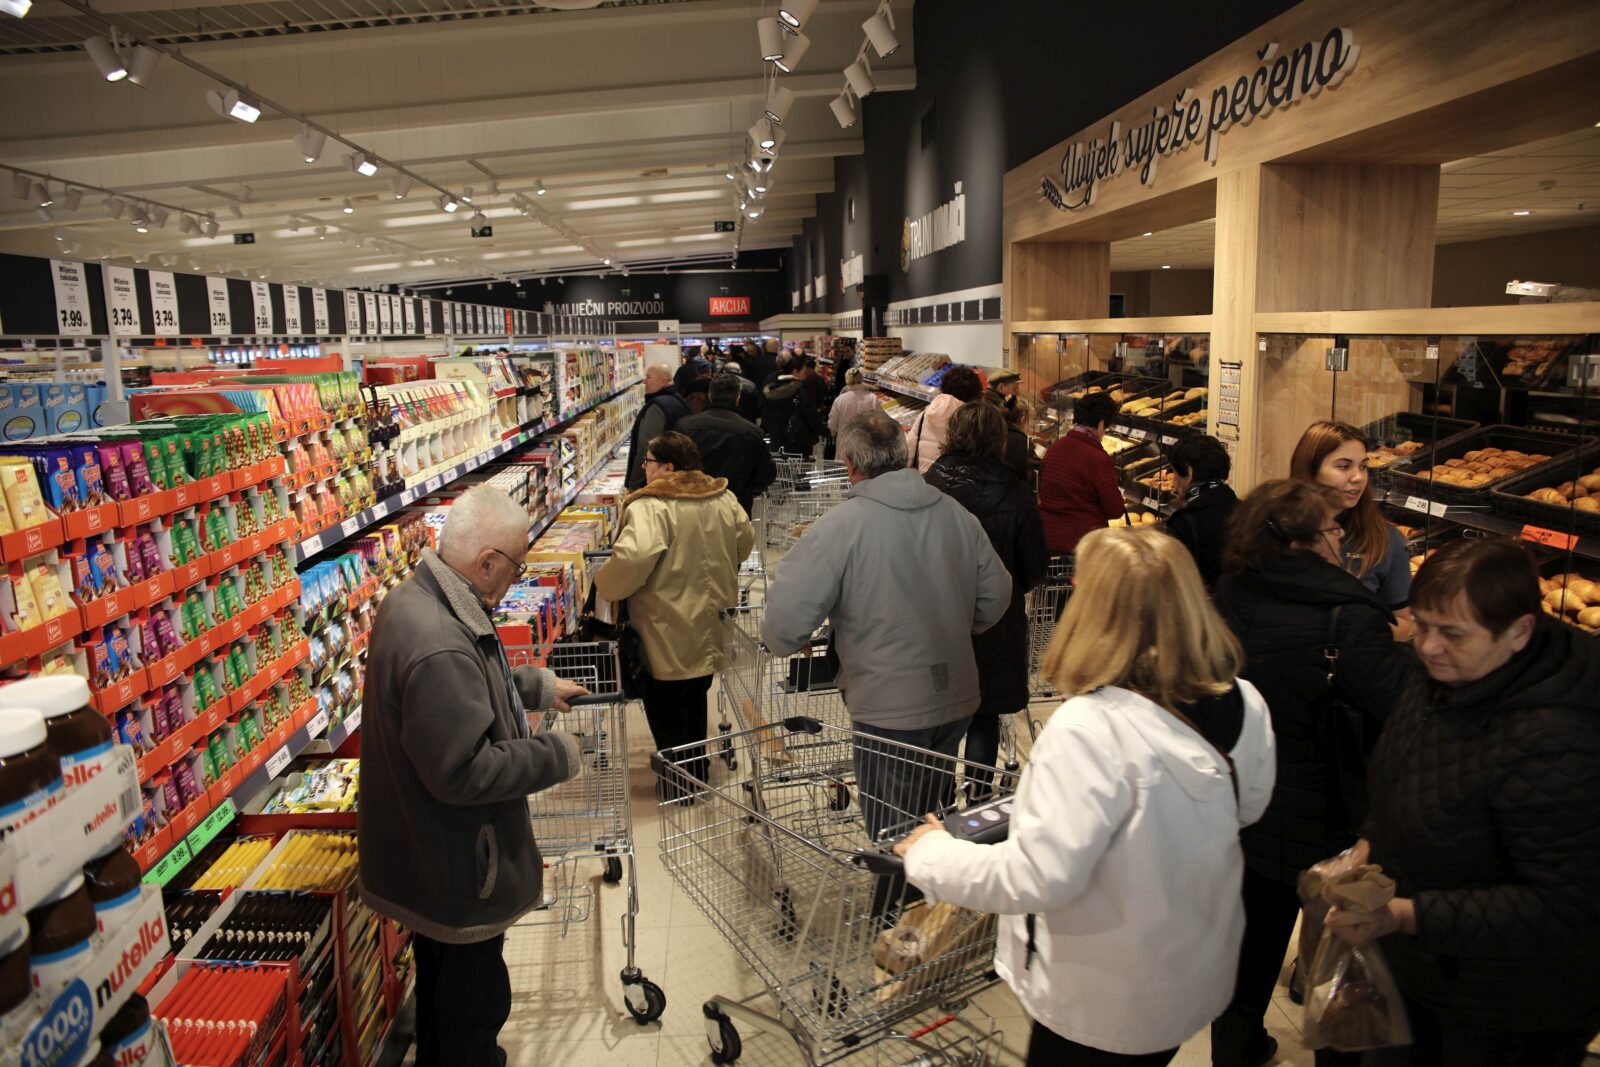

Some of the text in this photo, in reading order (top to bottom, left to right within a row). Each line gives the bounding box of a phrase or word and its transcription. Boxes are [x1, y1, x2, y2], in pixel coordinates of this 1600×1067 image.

[1061, 26, 1354, 205] Uvijek svježe pečeno
[608, 301, 664, 315] PROIZVODI
[712, 300, 748, 313] AKCIJA
[61, 309, 82, 327] 7.99
[112, 308, 132, 326] 3.79
[154, 309, 173, 327] 3.79
[212, 312, 227, 327] 3.79
[84, 801, 117, 835] nutella
[171, 847, 185, 864] 9.99
[96, 913, 164, 1009] nutella
